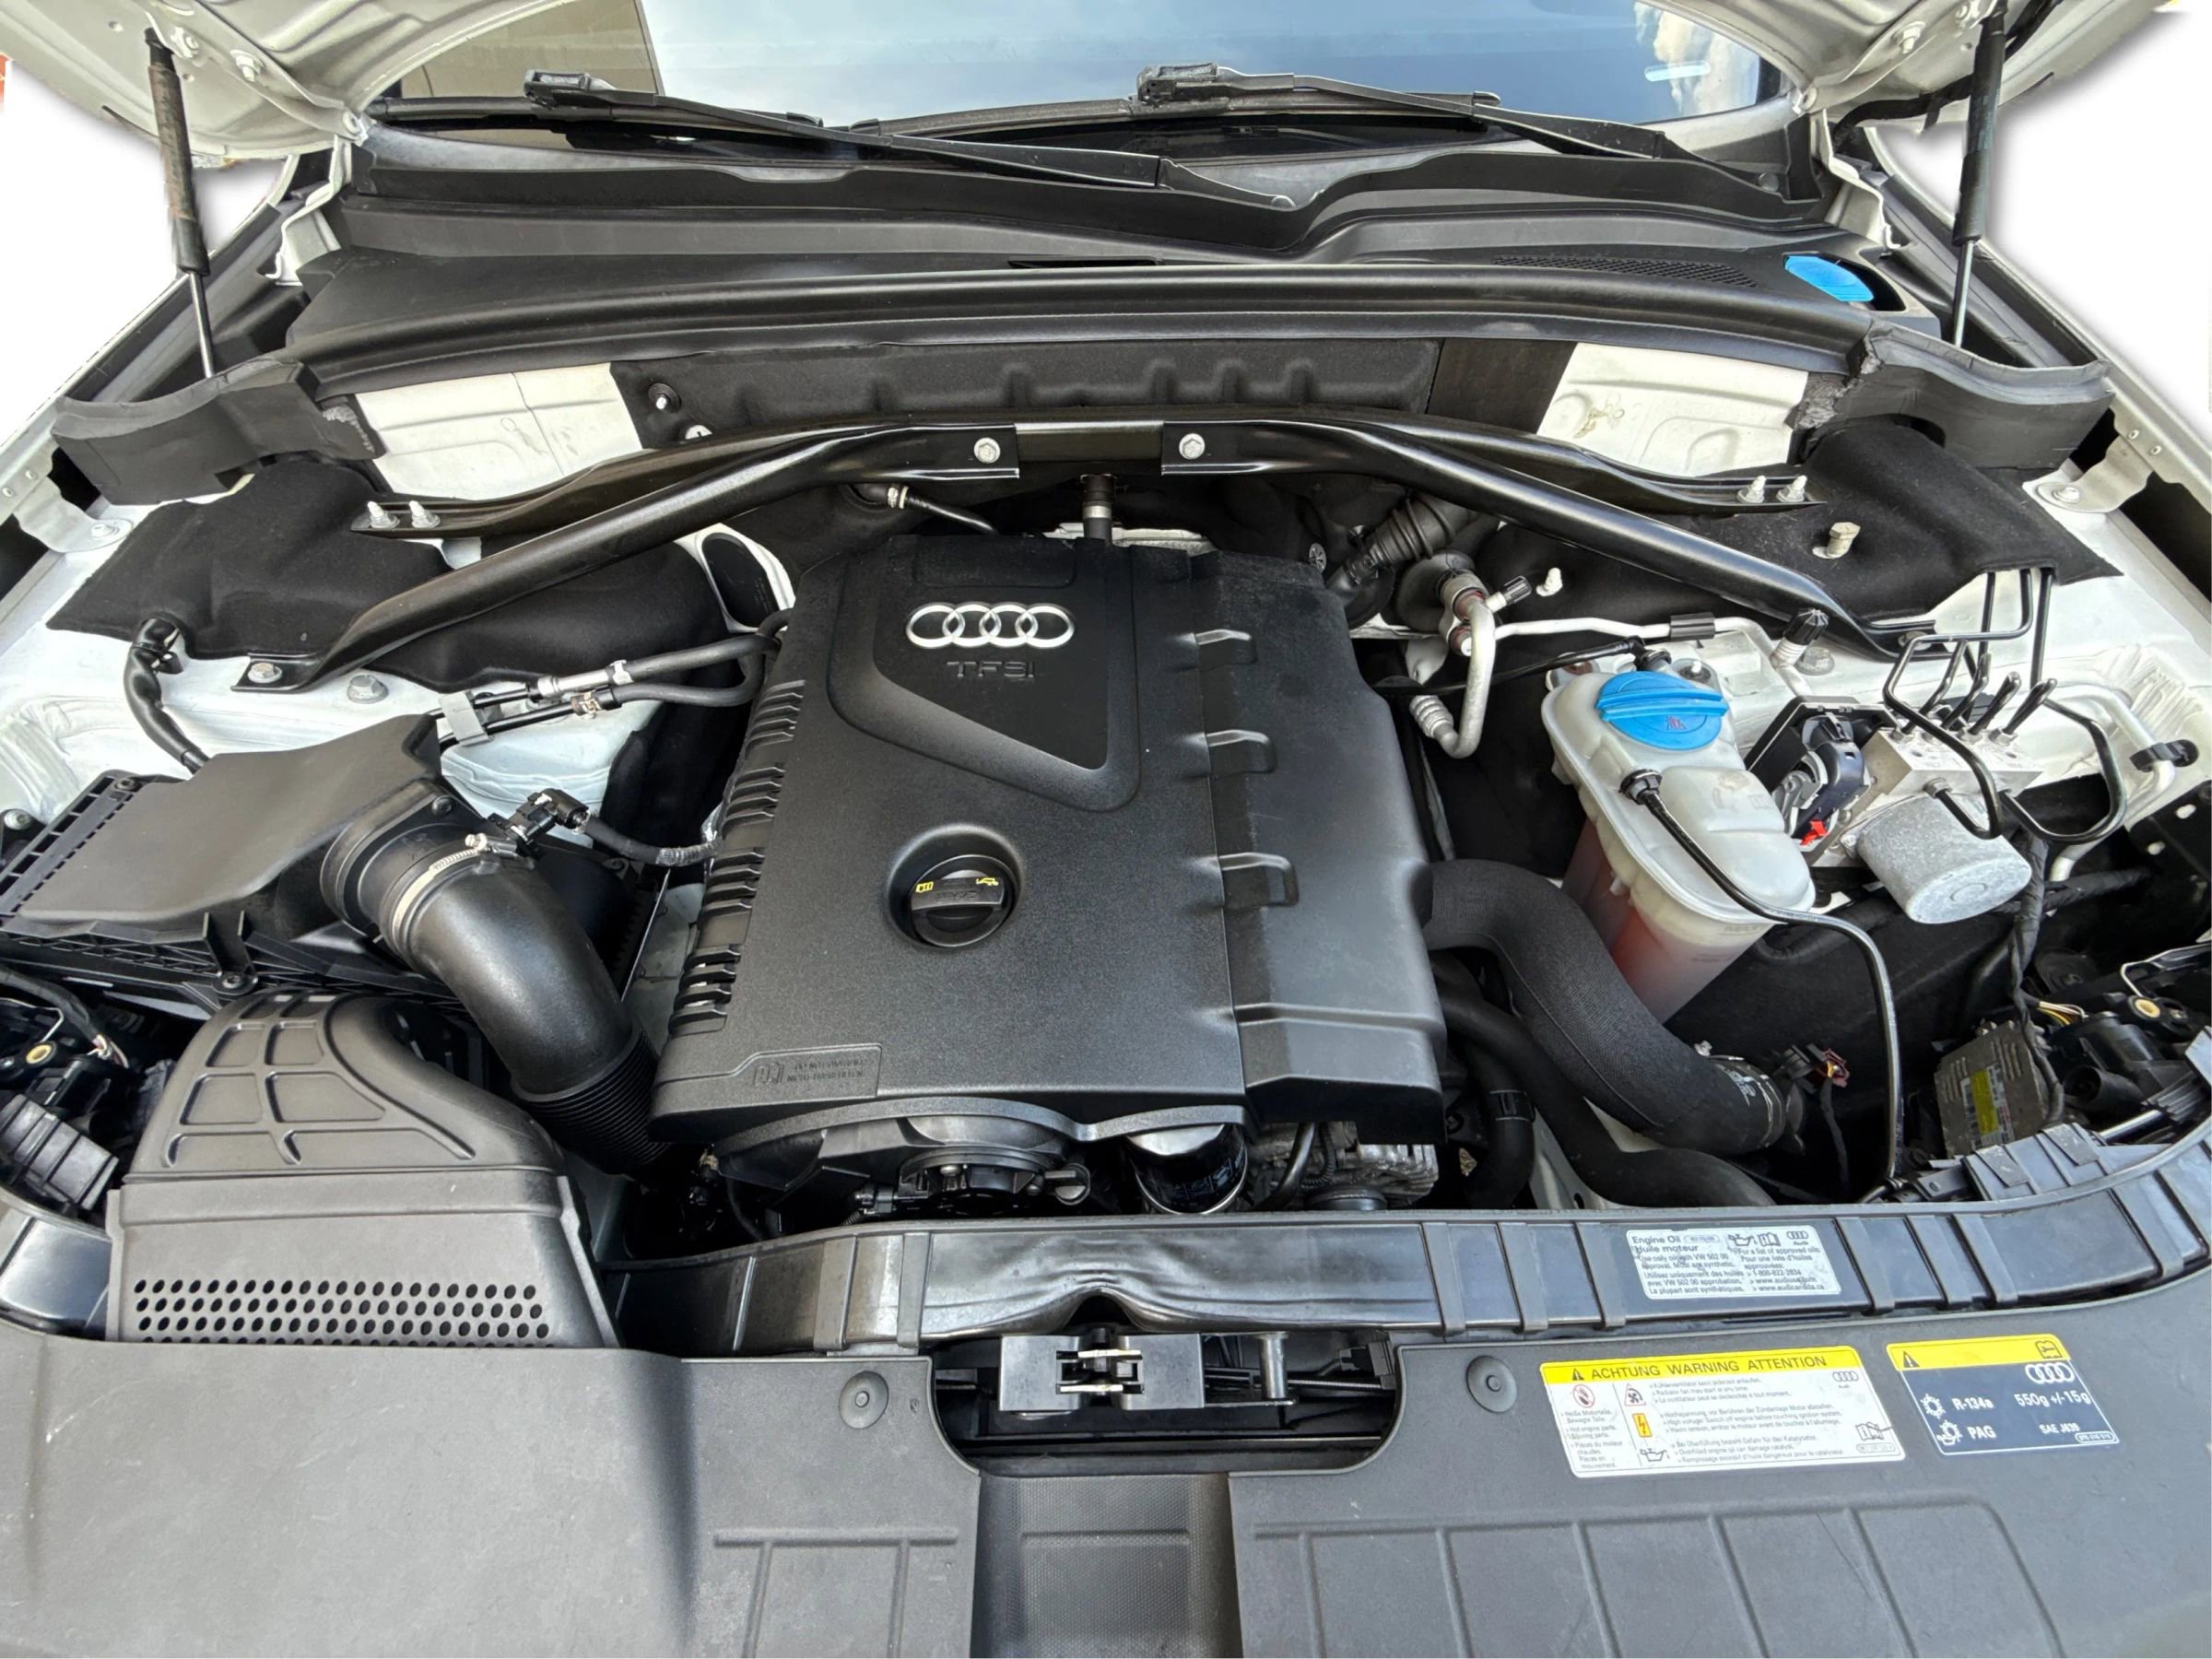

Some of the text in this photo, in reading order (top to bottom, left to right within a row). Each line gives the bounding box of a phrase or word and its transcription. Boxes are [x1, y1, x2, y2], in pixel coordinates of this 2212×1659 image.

[947, 660, 1036, 679] TFSI
[1632, 1236, 1665, 1245] Engine
[1667, 1235, 1681, 1243] Oil
[1634, 1245, 1660, 1253] Huile
[1592, 1357, 1826, 1379] ACHTUNG WARNING ATTENTION
[1952, 1397, 1994, 1410] R-134a
[2015, 1394, 2050, 1406] 550g
[1968, 1423, 2080, 1439] PAG SAE J639
